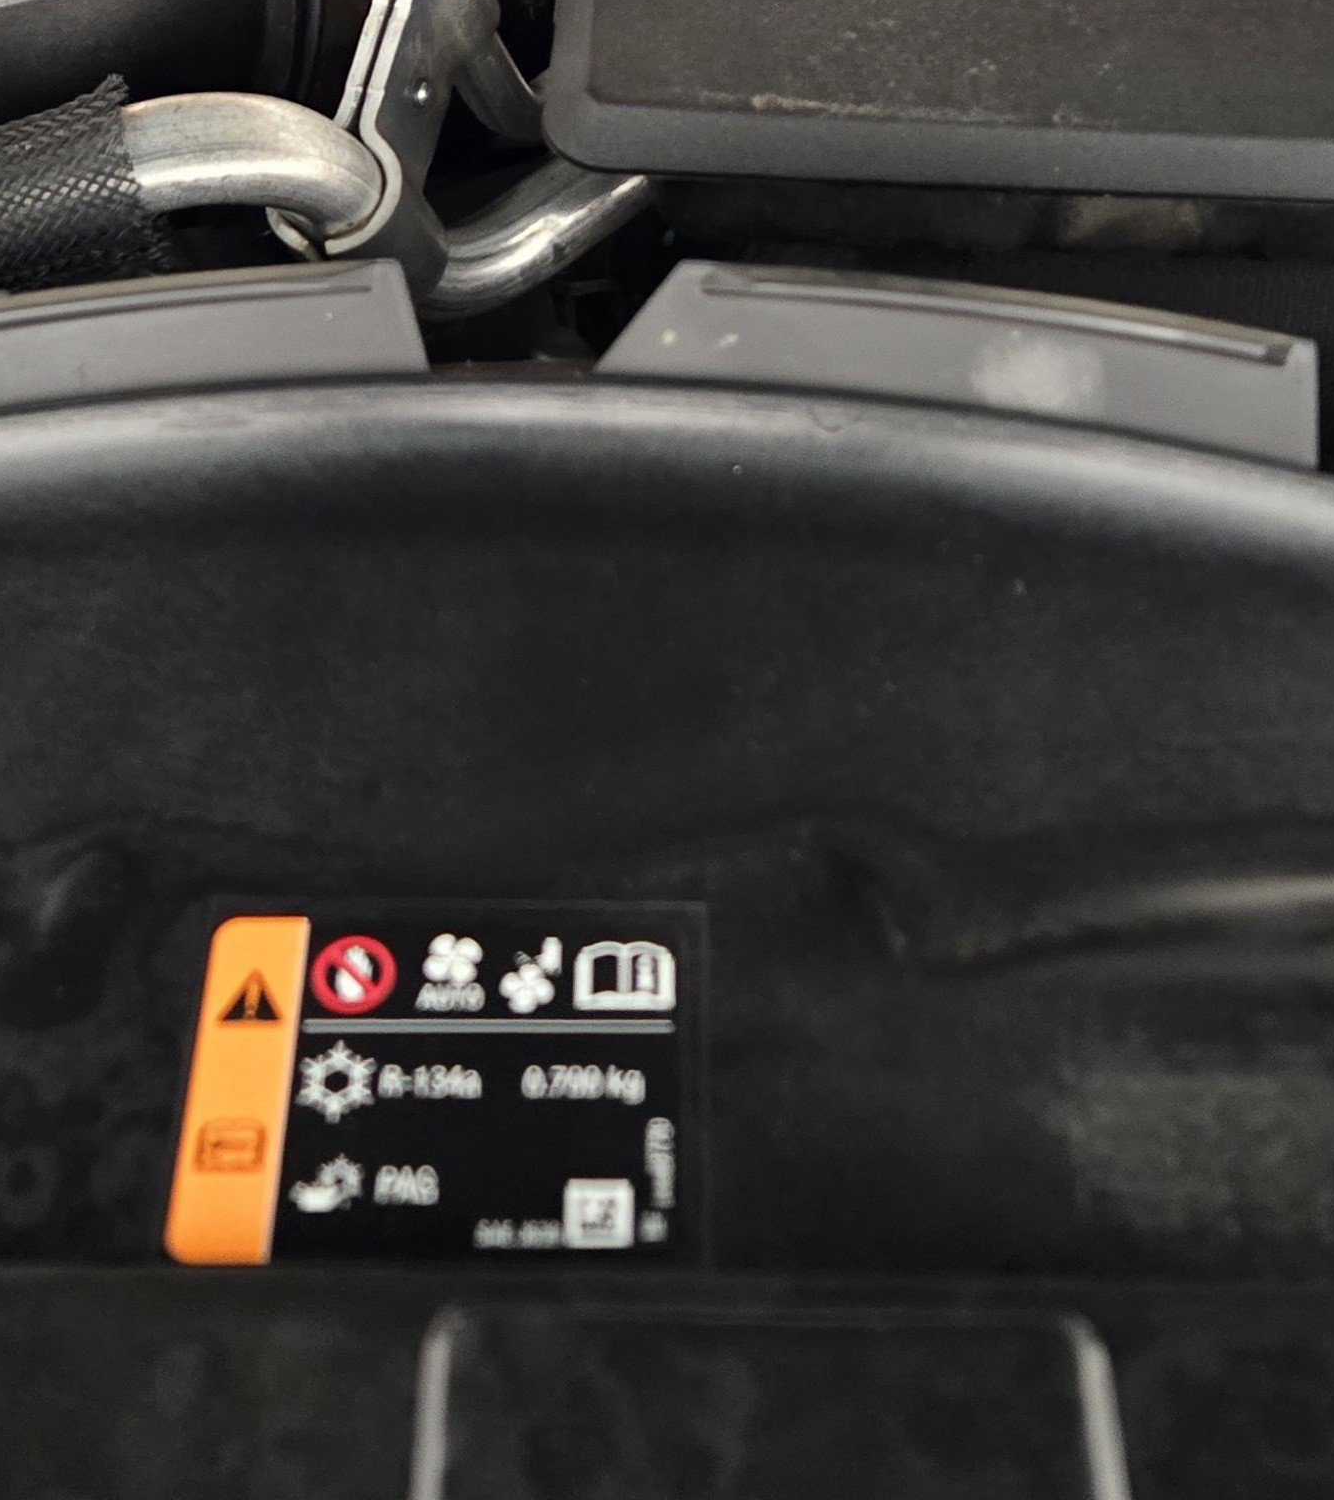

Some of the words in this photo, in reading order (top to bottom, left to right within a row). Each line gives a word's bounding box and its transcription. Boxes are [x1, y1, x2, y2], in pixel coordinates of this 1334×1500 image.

[376, 1063, 482, 1100] R-134a
[605, 1063, 646, 1105] kg
[373, 1163, 440, 1206] PAG
